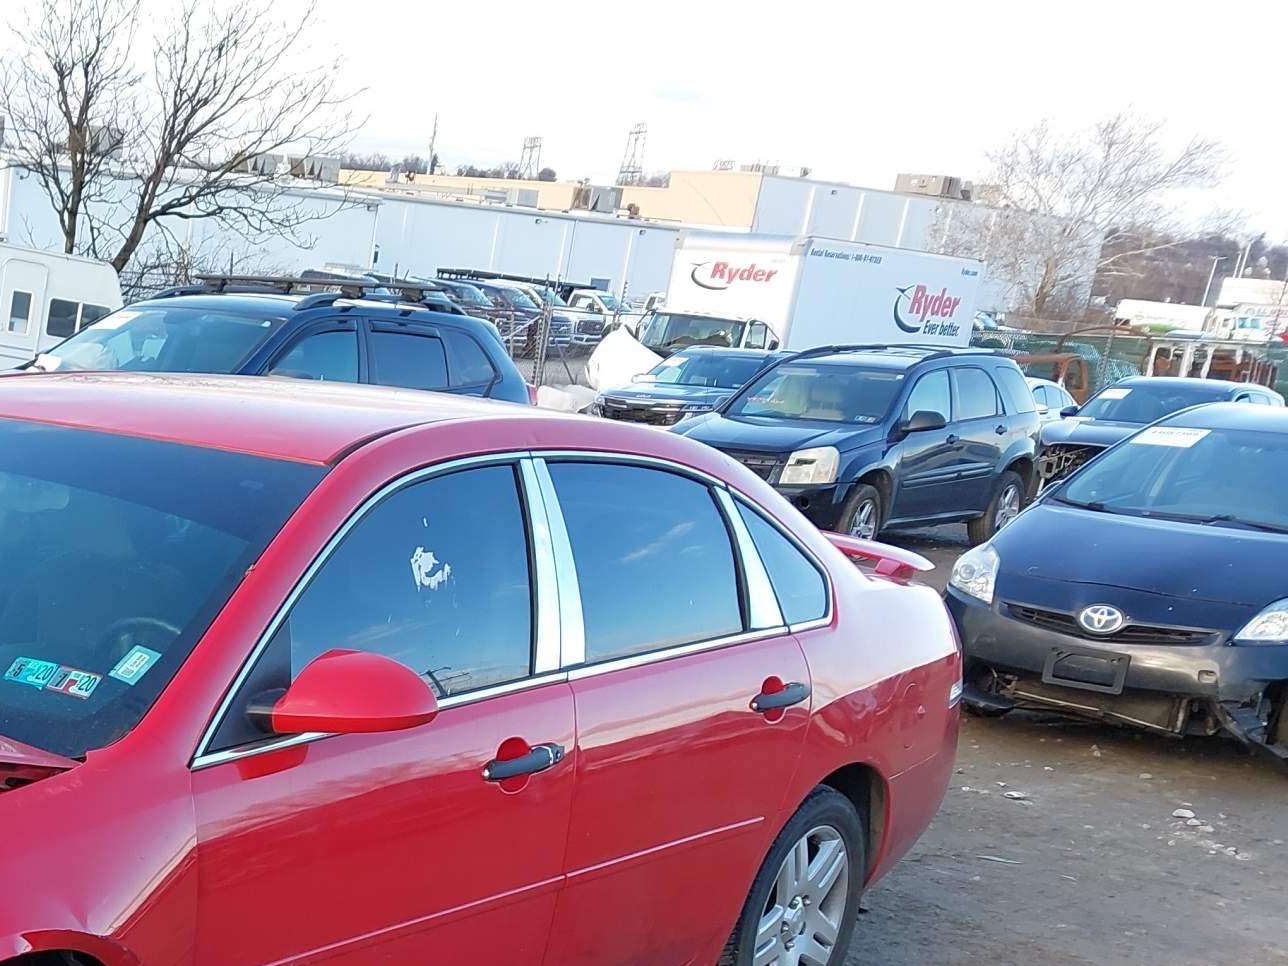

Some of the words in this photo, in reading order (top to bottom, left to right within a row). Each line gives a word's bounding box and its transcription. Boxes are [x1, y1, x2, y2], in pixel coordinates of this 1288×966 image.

[710, 261, 779, 284] Ryder
[908, 285, 961, 322] Ryder
[923, 320, 940, 335] Ever
